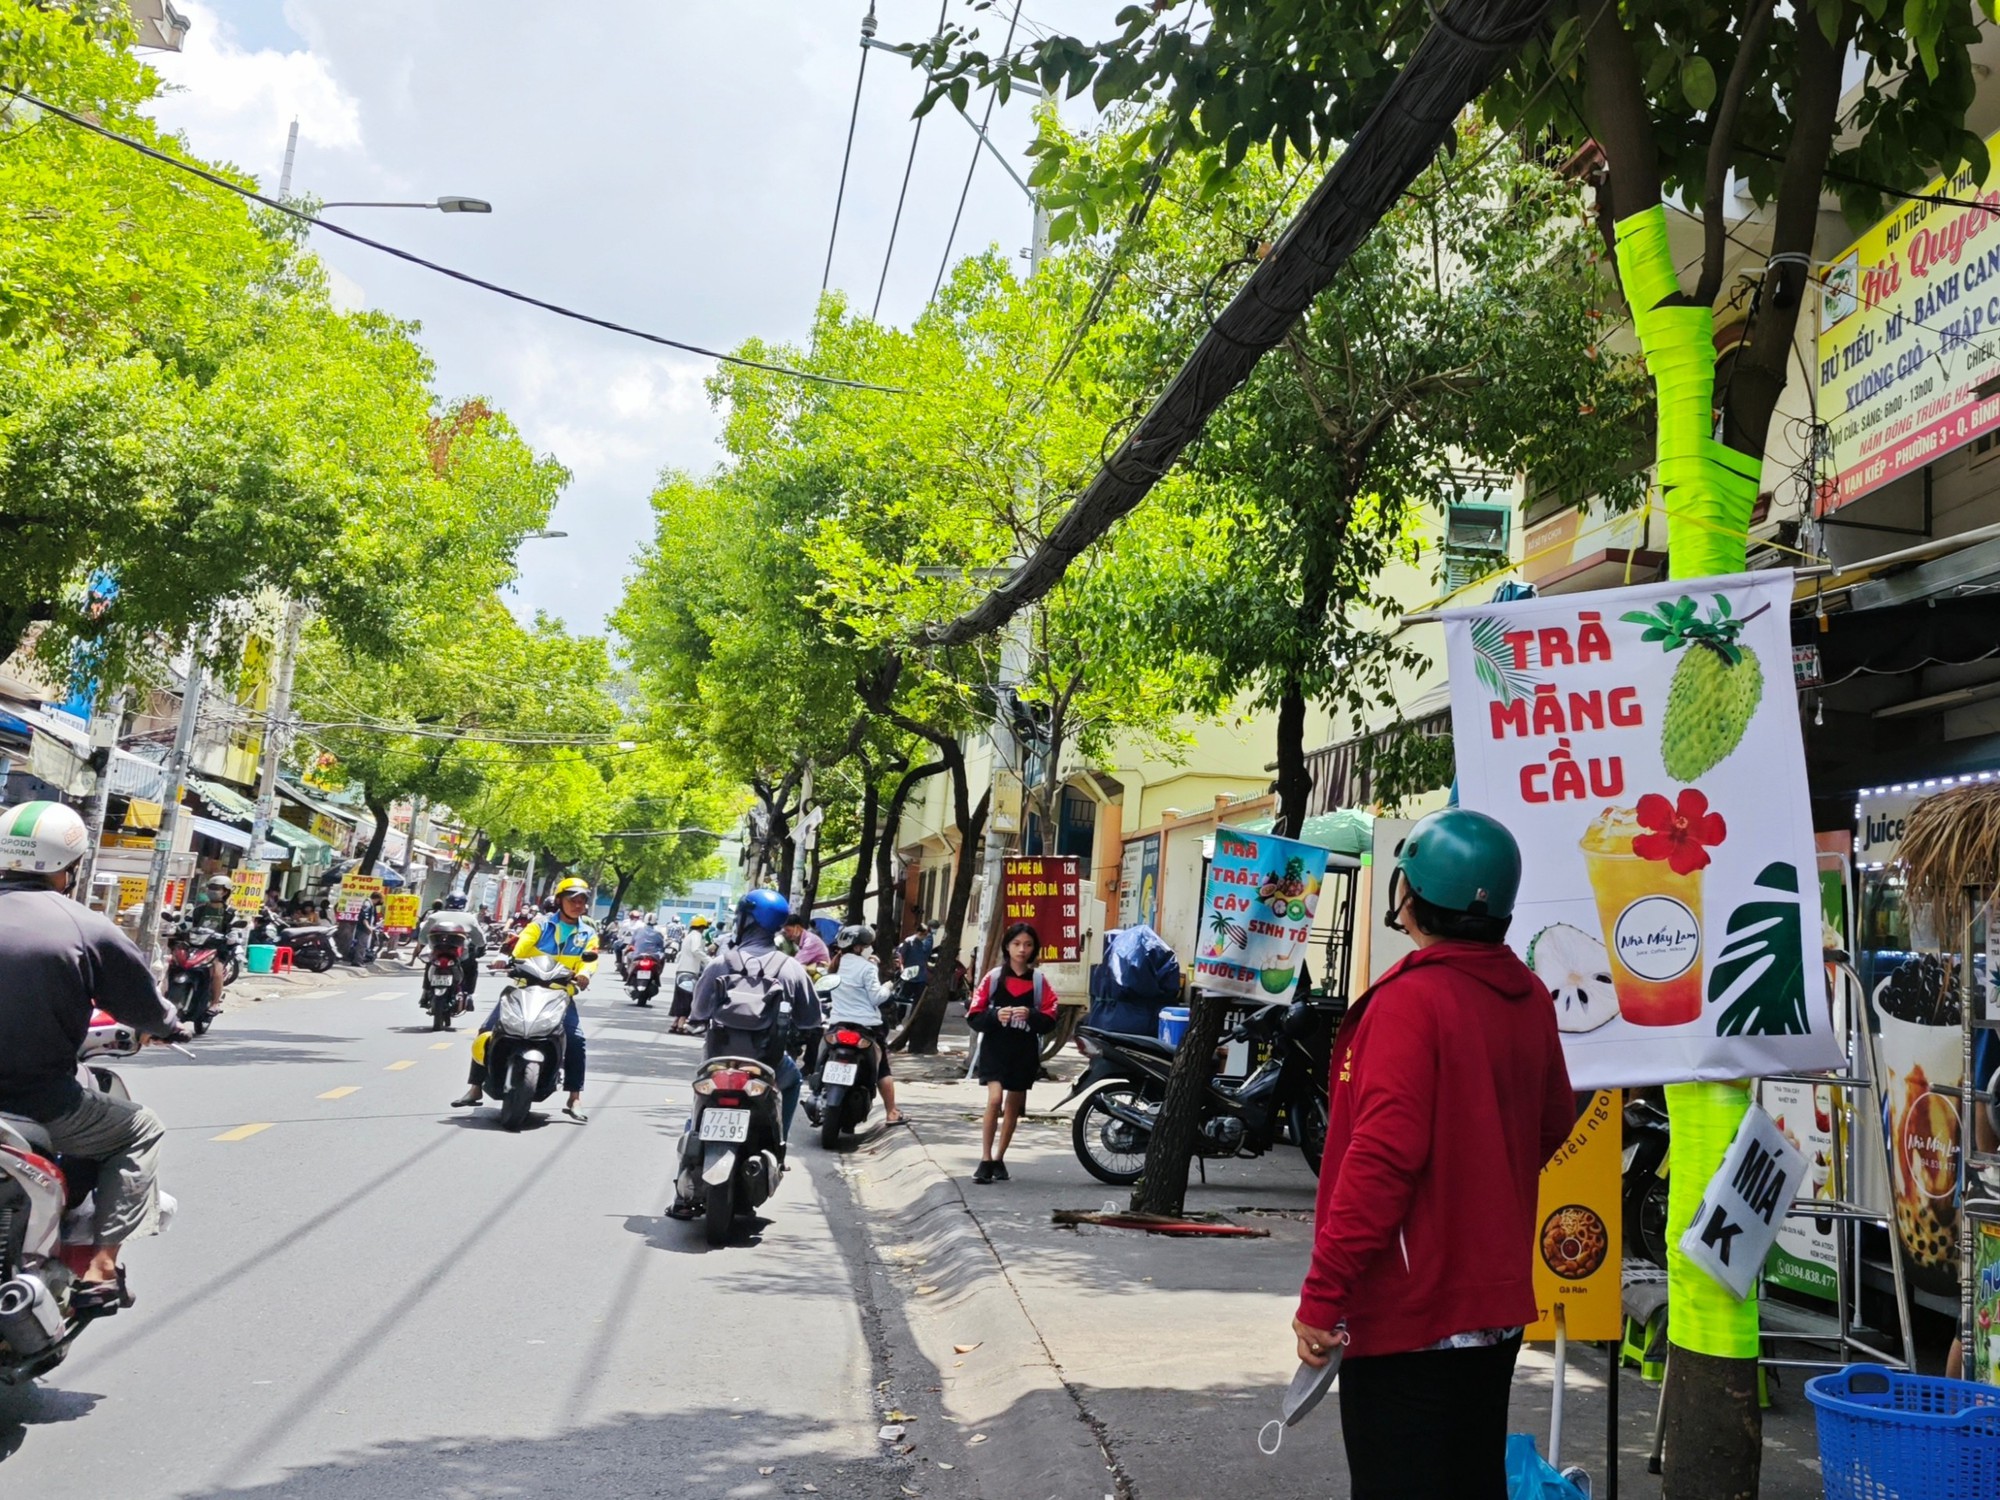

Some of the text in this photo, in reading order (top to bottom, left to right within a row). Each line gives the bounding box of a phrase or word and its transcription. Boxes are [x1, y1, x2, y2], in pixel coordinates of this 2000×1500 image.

[1886, 215, 1900, 246] HỦ
[1904, 201, 1926, 233] TIẾU
[1861, 251, 1902, 312] Hà
[1820, 344, 1839, 387] HỦ
[1843, 323, 1874, 372] TIẾU
[1885, 303, 1903, 345] MÌ
[1914, 283, 1960, 326] BÁNH
[1845, 362, 1894, 411] XƯƠNG
[1897, 337, 1924, 381] GIÒ
[1939, 306, 1983, 355] THẬP
[1884, 395, 1902, 418] 6h00
[1910, 376, 1933, 403] 13h00
[1916, 392, 1951, 425] TRÙNG
[1844, 471, 1863, 495] VẠN
[1865, 456, 1886, 484] KIẾP
[1895, 432, 1937, 469] PHƯỜNG
[1939, 426, 1947, 445] 3
[1957, 417, 1968, 436] Q.
[1971, 397, 2000, 429] BÌNH
[1503, 610, 1612, 670] TRÀ
[1489, 683, 1643, 740] MÃNG
[1518, 737, 1625, 804] CẦU
[1863, 812, 1905, 851] Juice
[0, 848, 36, 857] PHARMA
[1222, 840, 1258, 859] TRÀ
[1007, 860, 1076, 875] CÀ PHÊ ĐÁ 12K
[1213, 868, 1259, 887] TRÁI
[231, 886, 261, 896] 27.000
[1007, 880, 1076, 896] CÀ PHÊ SỮA ĐÁ 15K
[1007, 900, 1076, 917] TRÀ TẮC 12K
[1213, 894, 1250, 912] CÂY
[1063, 925, 1076, 938] 15K
[1248, 919, 1309, 943] SINH TỐ
[1621, 935, 1644, 949] Nhà
[1675, 930, 1696, 945] Lam
[1063, 946, 1077, 959] 20K
[1237, 970, 1255, 983] ÉP
[710, 1112, 741, 1125] 77-L1
[1554, 1089, 1612, 1166] siêu ngo
[703, 1125, 744, 1139] 975.95
[1732, 1138, 1786, 1226] MÍA
[1701, 1204, 1744, 1267] K
[1785, 1264, 1837, 1288] 0394.838.477
